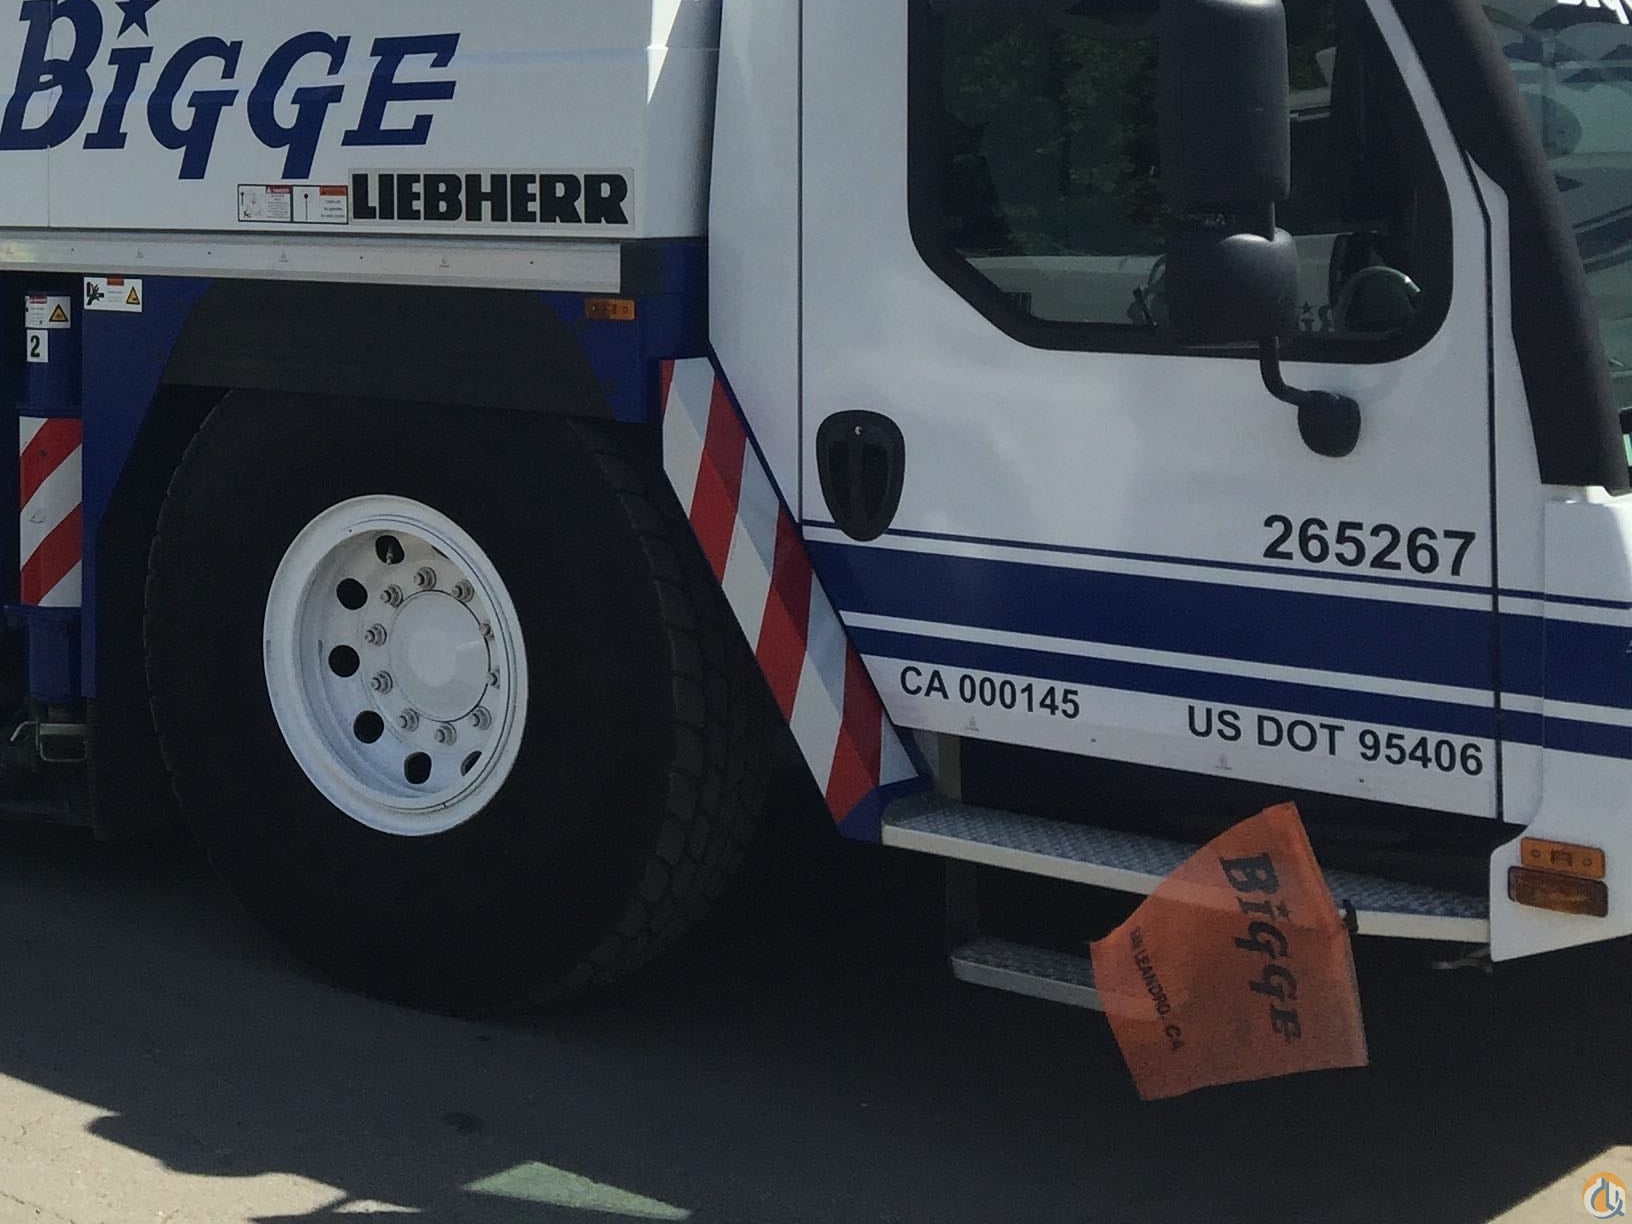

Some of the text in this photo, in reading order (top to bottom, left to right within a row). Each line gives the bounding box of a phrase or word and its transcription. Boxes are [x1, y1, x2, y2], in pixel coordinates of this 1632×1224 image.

[352, 173, 629, 225] LIEBHERR
[30, 334, 41, 358] 2
[1262, 514, 1476, 577] 265267
[900, 665, 1081, 720] CA 000145
[1187, 704, 1484, 776] US DOT 95406
